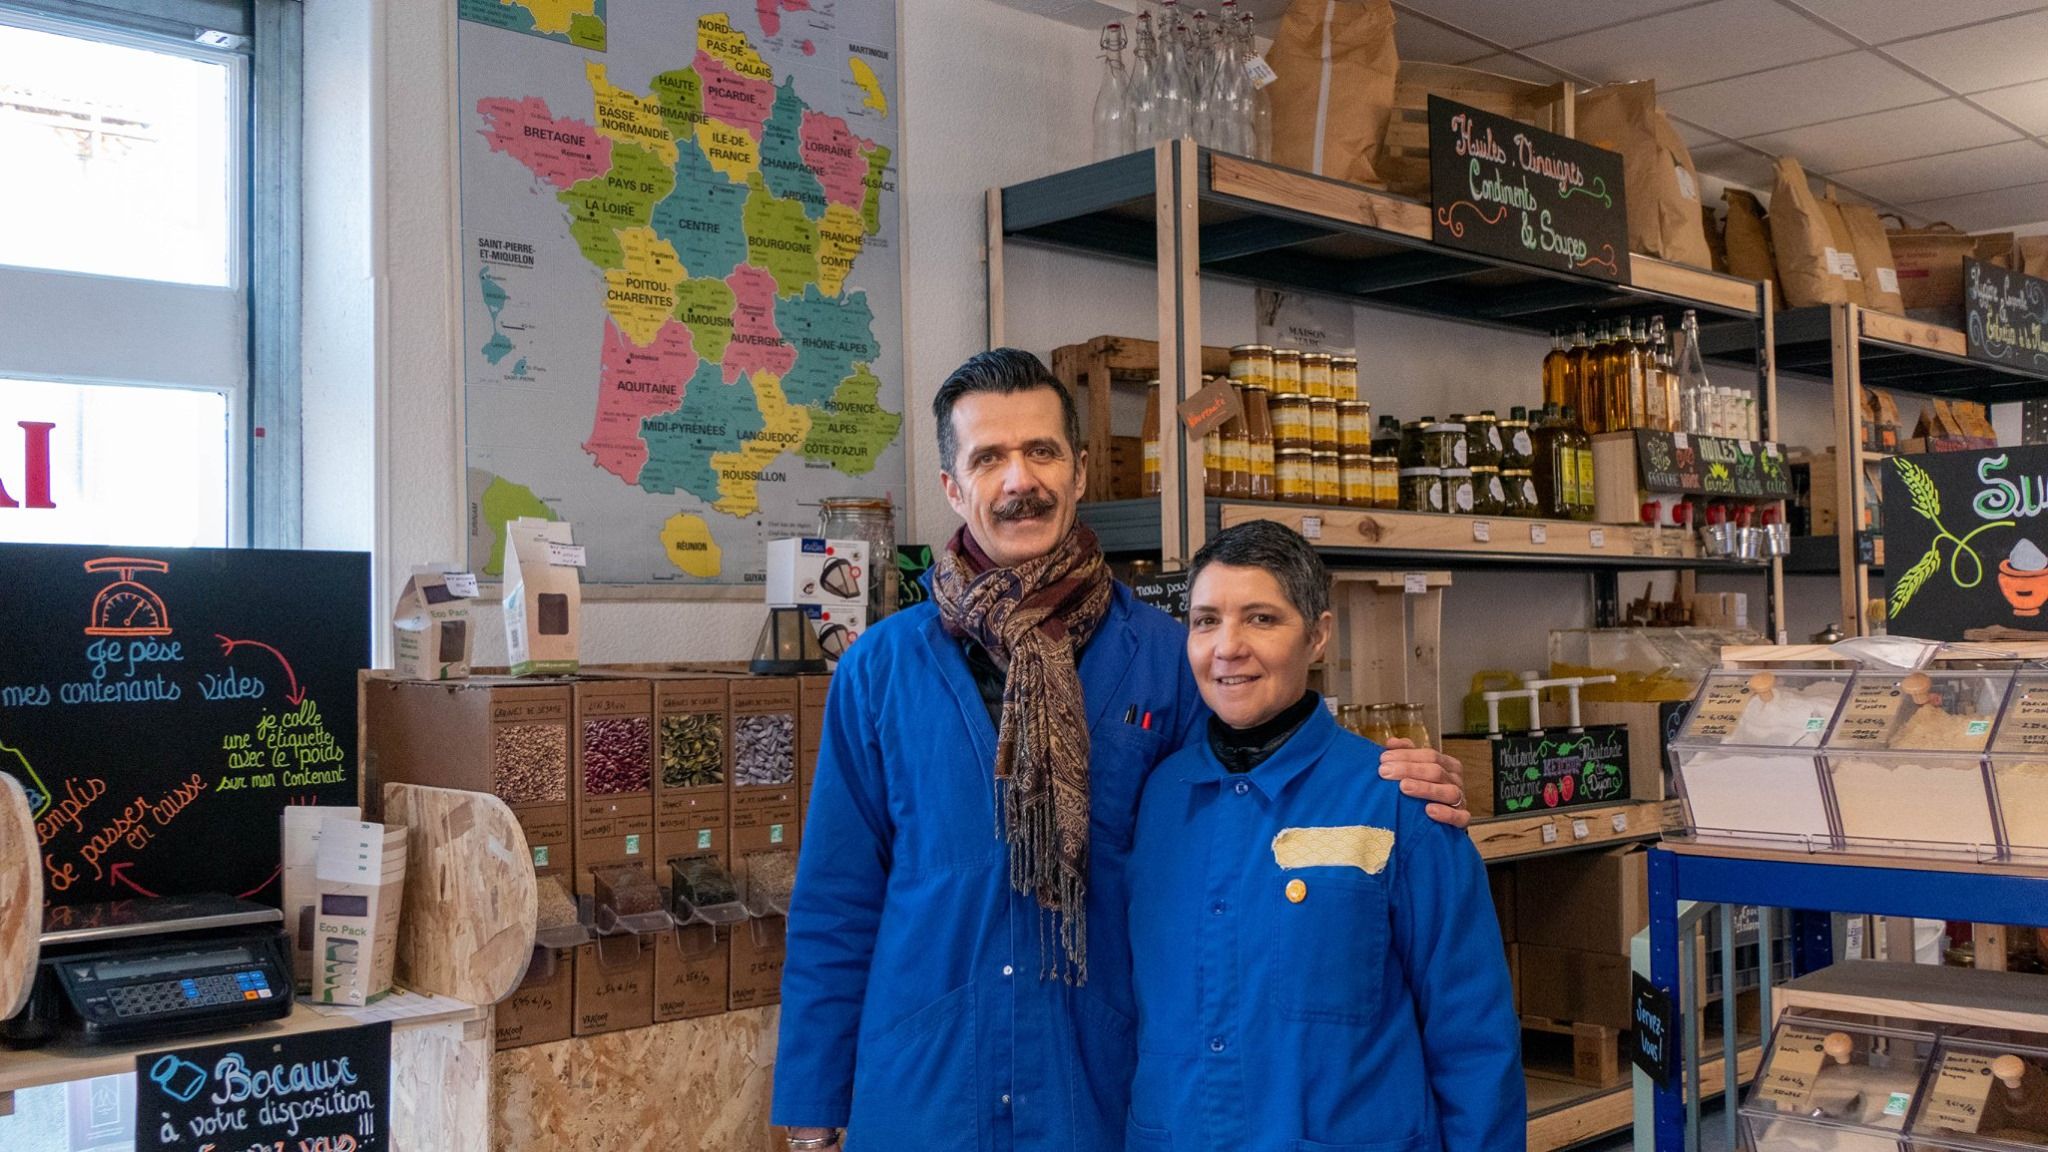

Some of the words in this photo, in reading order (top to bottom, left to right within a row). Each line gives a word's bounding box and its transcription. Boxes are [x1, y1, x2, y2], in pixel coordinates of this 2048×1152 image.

[706, 40, 747, 56] PAS-DE-
[849, 43, 889, 60] MARTINIQUE
[735, 62, 772, 78] CALAIS
[658, 75, 698, 91] HAUTE-
[708, 86, 756, 104] PICARDIE
[599, 105, 639, 122] BASSE-
[643, 103, 709, 125] NORMANDIE
[524, 126, 586, 147] BRETAGNE
[602, 118, 669, 141] NORMANDIE
[1451, 113, 1507, 164] Huiles
[709, 147, 751, 163] FRANCE
[805, 141, 853, 159] LORRAINE
[1513, 133, 1584, 193] Vinaigres
[608, 177, 637, 191] PAYS
[640, 182, 654, 193] DE
[860, 177, 895, 192] ALSACE
[1469, 159, 1537, 212] Condiments
[782, 189, 827, 206] ARDENNE
[585, 199, 600, 212] LA
[602, 202, 635, 217] LOIRE
[679, 218, 720, 234] CENTRE
[478, 237, 536, 253] SAINT-PIERRE-
[749, 235, 812, 255] BOURGOGNE
[1521, 211, 1537, 250] &
[1540, 209, 1587, 269] Soupes
[479, 249, 535, 265] ET-MIQUELON
[607, 289, 673, 308] CHARENTES
[681, 312, 735, 329] LIMOUSIN
[731, 333, 786, 348] AUVERGNE
[1288, 326, 1327, 339] MAISON
[802, 335, 868, 355] RHÔNE-ALPES
[617, 379, 678, 396] AQUITAINE
[643, 419, 727, 437] MIDI-PYRÉNÉES
[804, 442, 868, 457] CÔTE-D'AZUR
[1698, 437, 1738, 465] HUILES
[721, 469, 787, 483] ROUSSILLON
[1973, 454, 2048, 520] Su
[676, 540, 708, 552] RÉUNION
[744, 573, 766, 582] GUYAN
[1136, 584, 1164, 597] nous
[430, 609, 447, 619] Eco
[448, 608, 469, 617] Pack
[86, 637, 124, 681] Je
[128, 636, 184, 678] pèse
[1, 684, 50, 707] mes
[60, 673, 181, 704] contenants
[256, 706, 278, 740] je
[282, 699, 322, 728] colle
[222, 733, 252, 750] une
[267, 726, 332, 759] étiquette
[228, 750, 265, 768] avec
[272, 746, 290, 768] le
[300, 744, 344, 770] poids
[215, 776, 247, 792] sur
[127, 824, 157, 850] en
[152, 773, 208, 826] caisse
[80, 796, 153, 881] passer
[319, 922, 338, 934] Eco
[341, 923, 367, 937] Pack
[211, 1052, 358, 1105] Bocaux
[160, 1112, 180, 1143] à
[189, 1107, 248, 1137] votre
[259, 1090, 375, 1137] disposition
